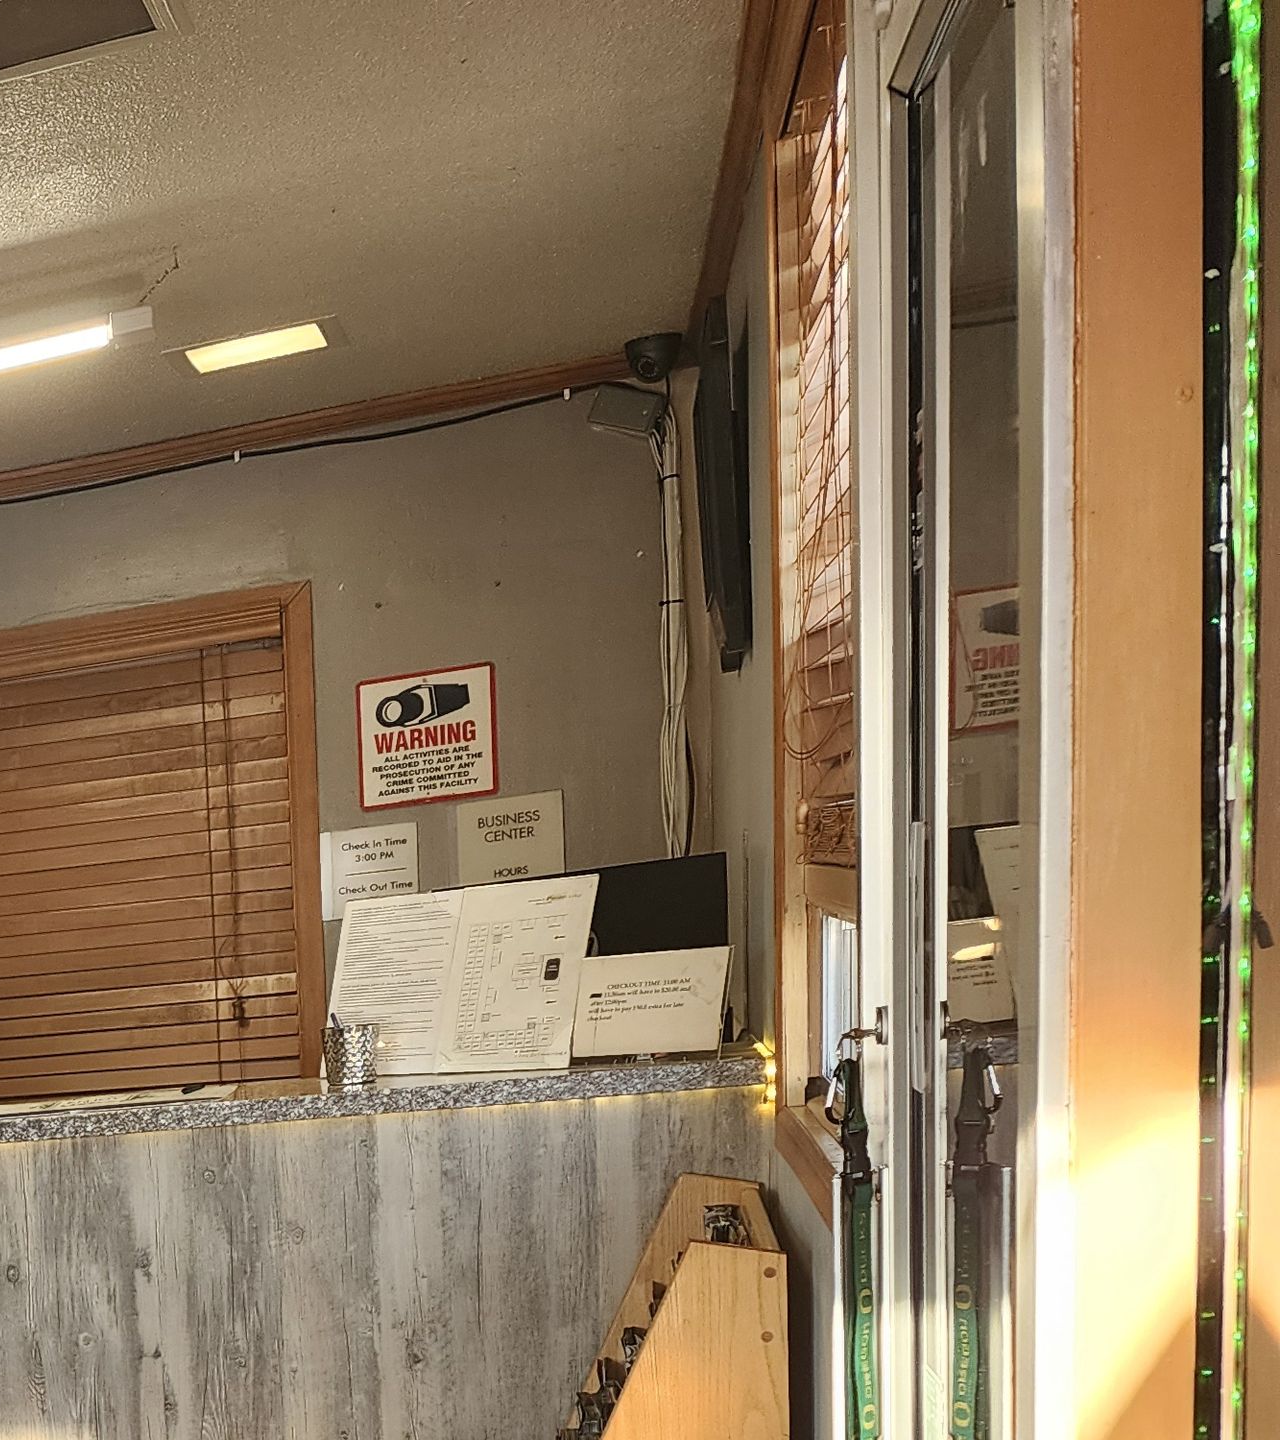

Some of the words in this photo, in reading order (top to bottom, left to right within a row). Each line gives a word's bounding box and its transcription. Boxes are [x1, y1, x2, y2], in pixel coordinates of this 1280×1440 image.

[373, 719, 477, 755] WARNING
[371, 761, 420, 773] RECORDED
[423, 758, 434, 766] TO
[436, 756, 452, 764] AID
[465, 752, 483, 760] THE
[383, 755, 400, 763] ALL
[402, 747, 450, 762] ACTIVITIES
[452, 745, 470, 753] ARE
[379, 766, 441, 780] PROSECUTION
[443, 764, 455, 772] OF
[457, 761, 476, 769] ANY
[385, 778, 414, 788] CRIME
[416, 770, 470, 784] COMMITTED
[378, 786, 415, 797] AGAINST
[417, 782, 438, 791] THIS
[439, 777, 479, 789] FACILITY
[477, 810, 541, 829] BUSINESS
[484, 827, 536, 843] CENTER
[341, 840, 370, 852] Check
[372, 839, 382, 849] In
[384, 837, 408, 848] Time
[355, 853, 377, 863] 3:00
[379, 851, 395, 860] PM
[493, 866, 529, 878] HOURS
[338, 884, 367, 896] Check
[372, 882, 388, 892] Out
[390, 880, 413, 890] Time
[860, 1322, 873, 1400] OREGON
